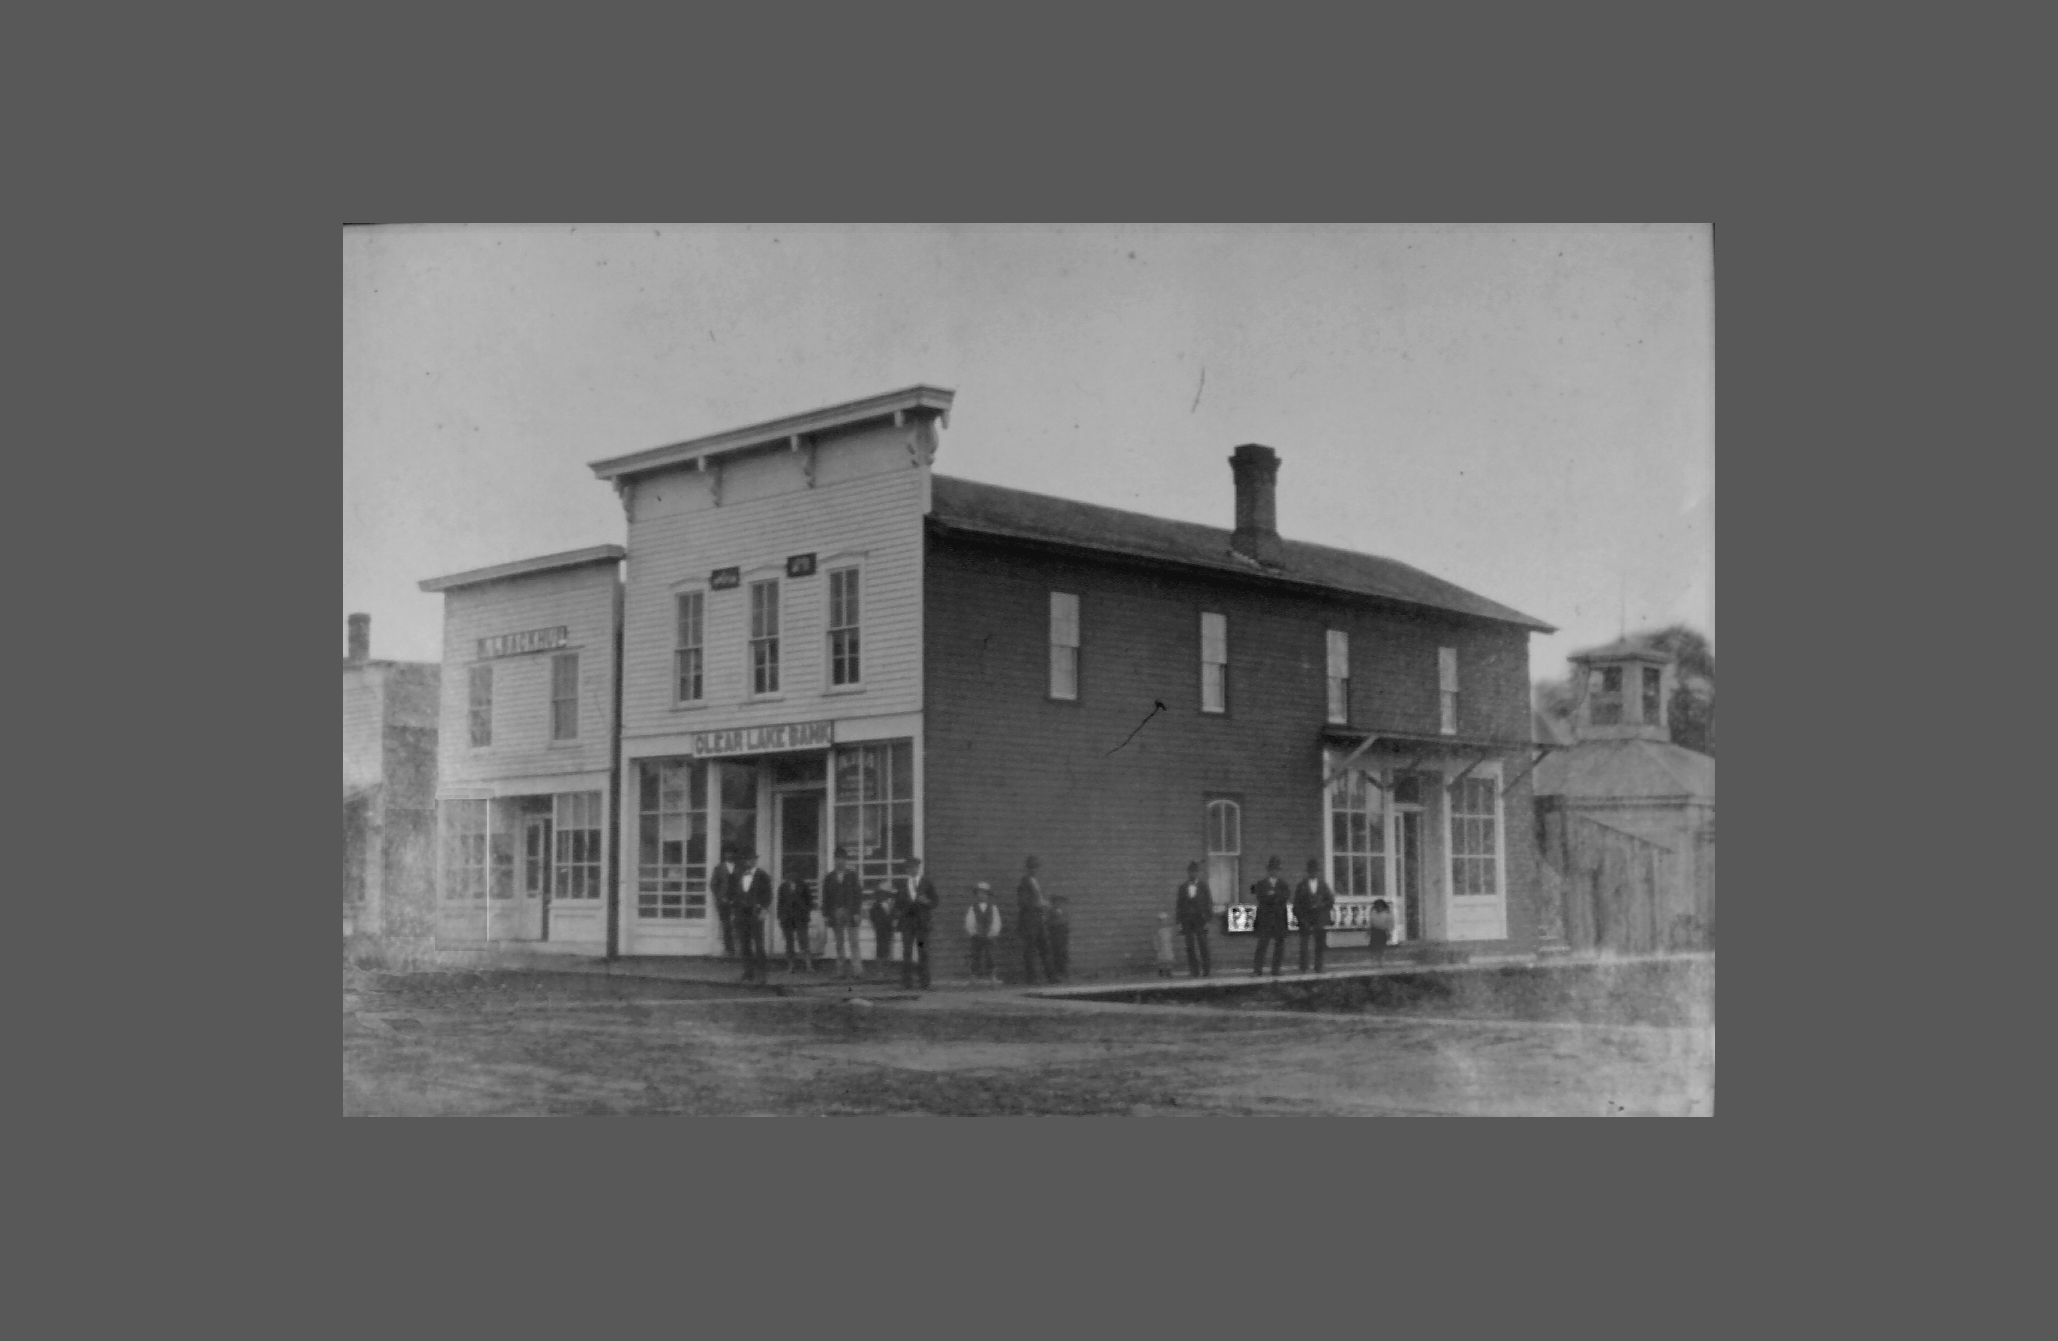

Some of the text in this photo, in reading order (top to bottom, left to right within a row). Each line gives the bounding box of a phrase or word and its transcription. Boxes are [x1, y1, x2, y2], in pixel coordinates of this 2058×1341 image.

[696, 722, 830, 753] CLEAR LAKE BANK
